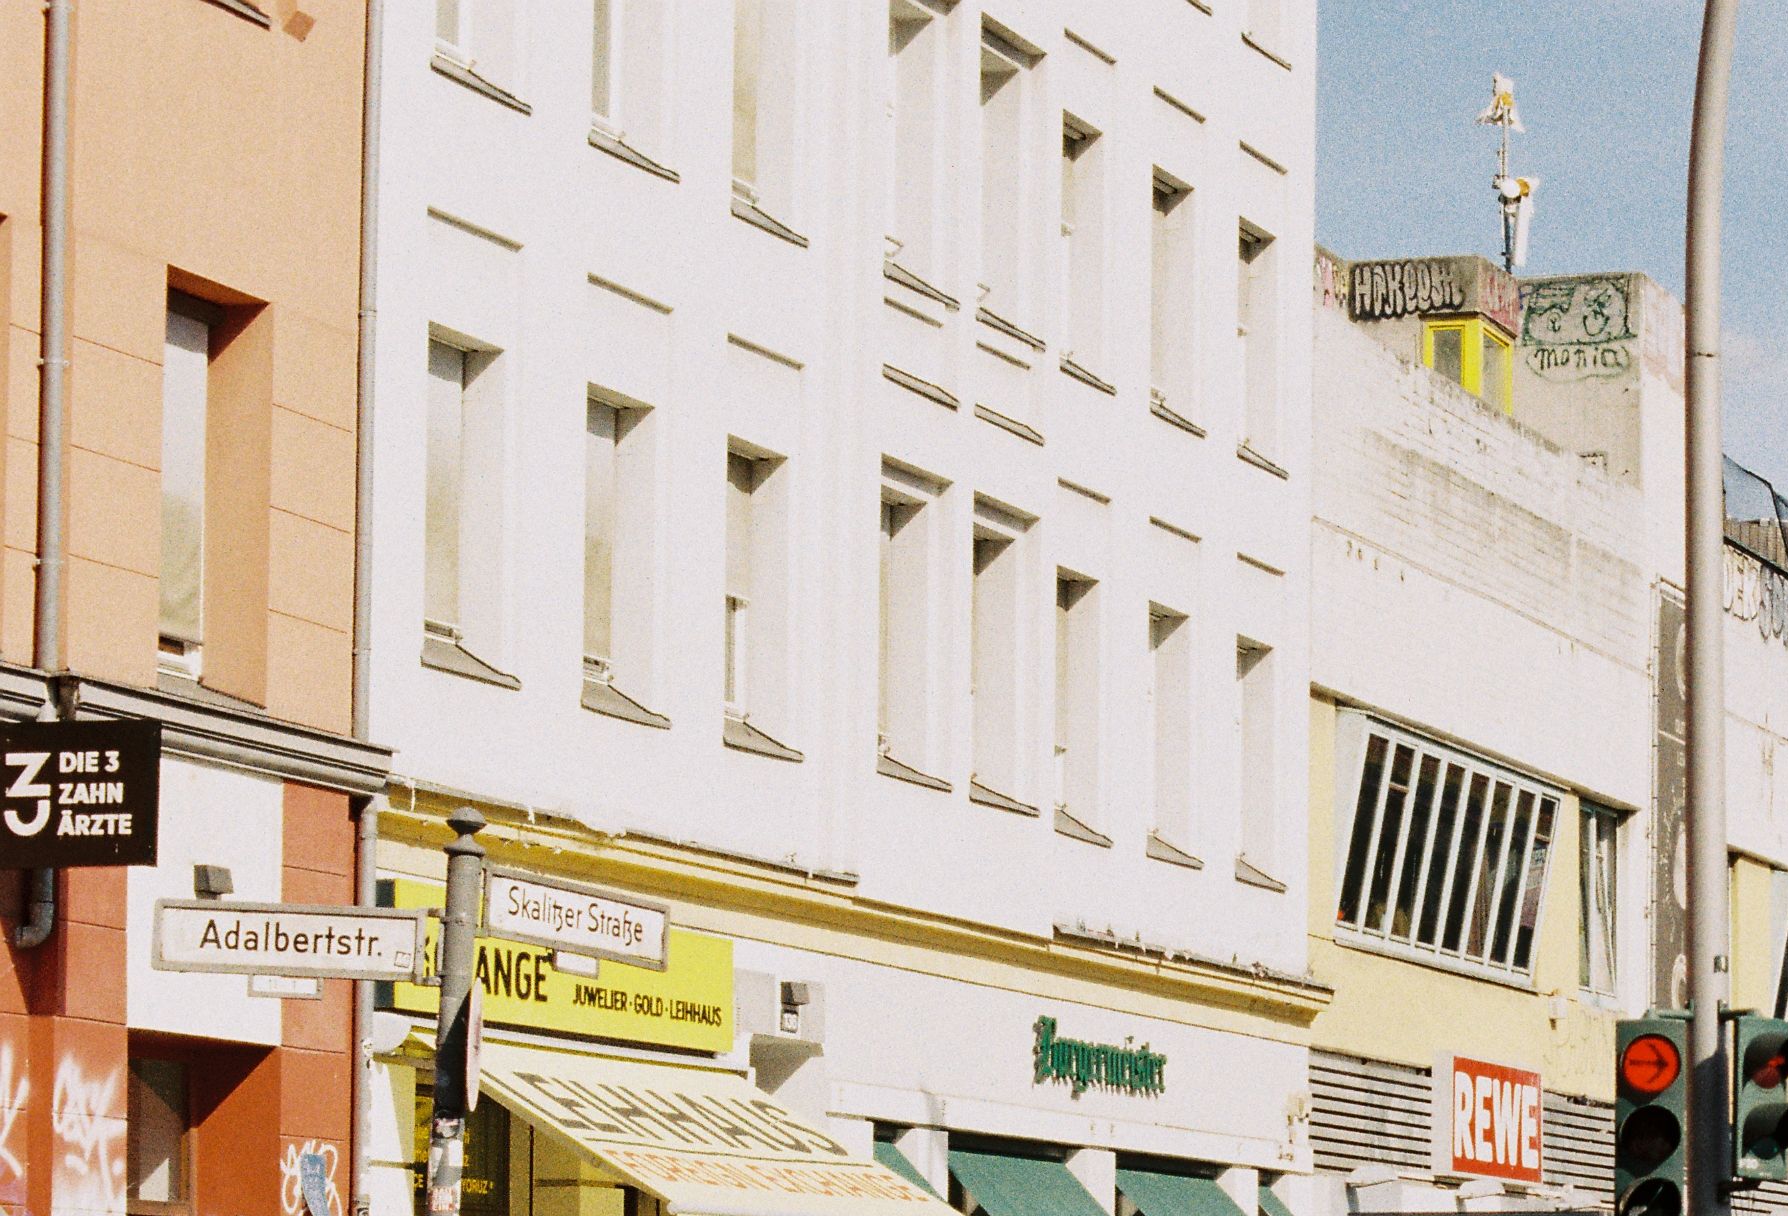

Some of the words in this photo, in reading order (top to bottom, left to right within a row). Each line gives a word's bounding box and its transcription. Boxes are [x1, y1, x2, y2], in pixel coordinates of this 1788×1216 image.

[59, 751, 99, 773] DIE
[104, 751, 120, 772] 3
[58, 783, 124, 804] ZAHN
[57, 810, 133, 836] ÄRZTE
[508, 886, 582, 932] Skalitzer
[587, 903, 644, 947] Straße
[200, 919, 382, 957] Adalbertstr.
[573, 983, 628, 1012] JUWELIER
[633, 993, 663, 1018] GOLD
[670, 1002, 722, 1027] LEIHHAUS
[481, 1068, 850, 1157] LEIHHAUS
[1454, 1071, 1539, 1169] REWE
[603, 1150, 771, 1191] FOREIGN
